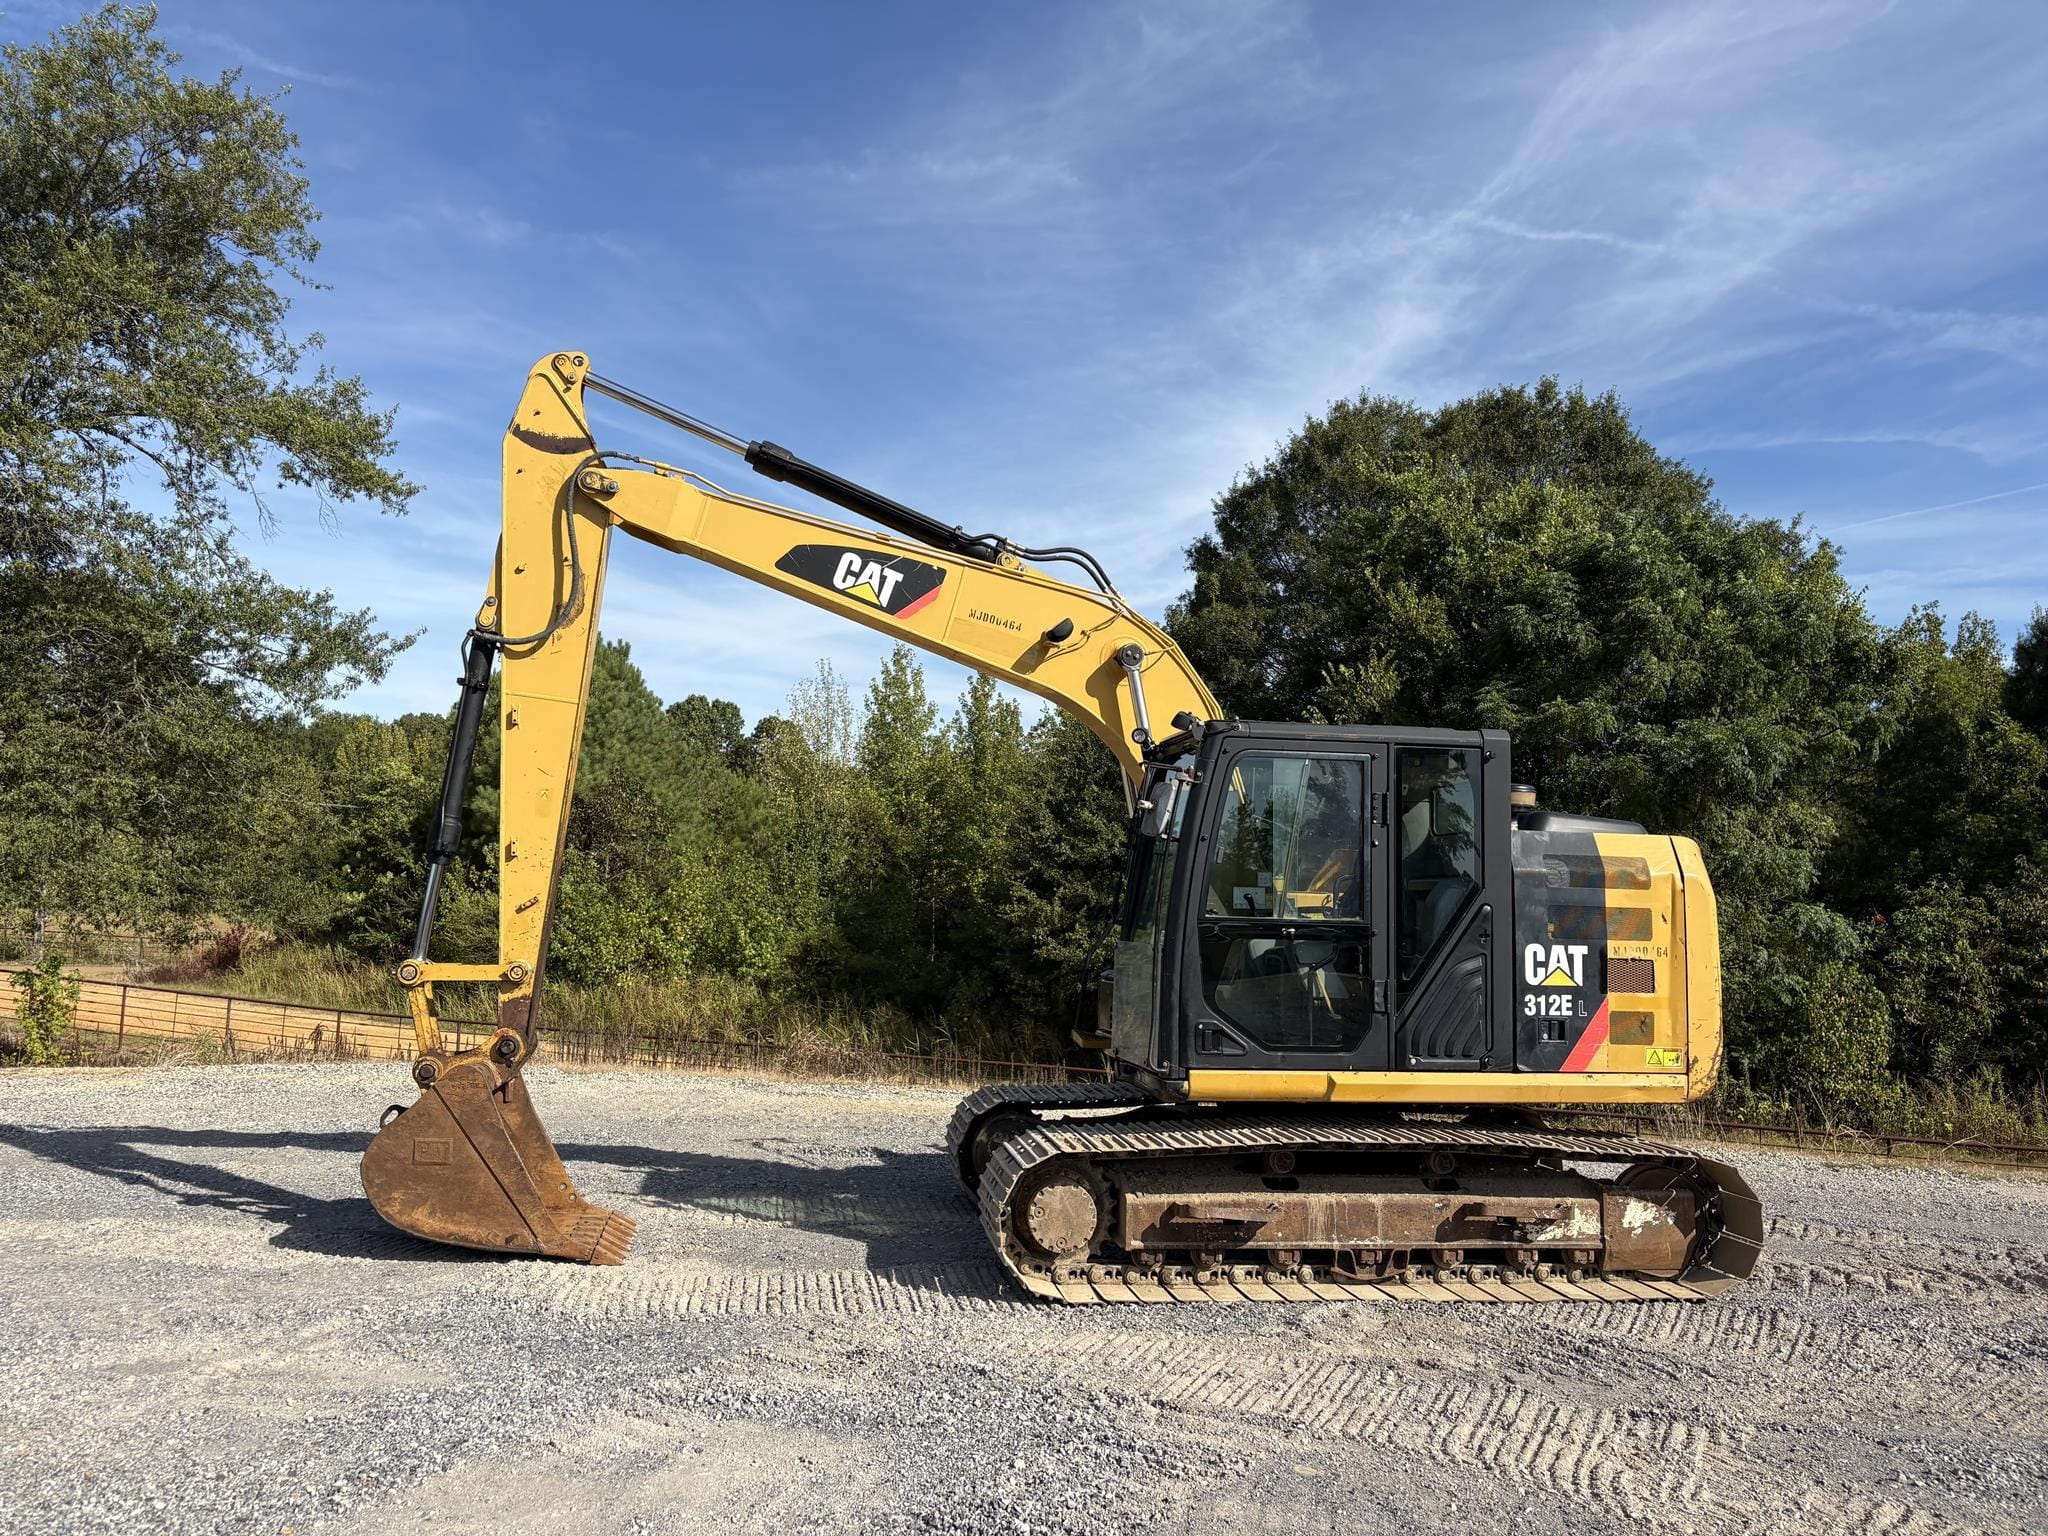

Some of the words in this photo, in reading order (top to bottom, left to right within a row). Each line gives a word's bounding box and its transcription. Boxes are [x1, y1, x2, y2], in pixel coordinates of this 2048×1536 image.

[833, 552, 904, 608] CAT
[1525, 944, 1588, 986] CAT
[1524, 995, 1573, 1016] 312E
[1578, 1000, 1587, 1016] L
